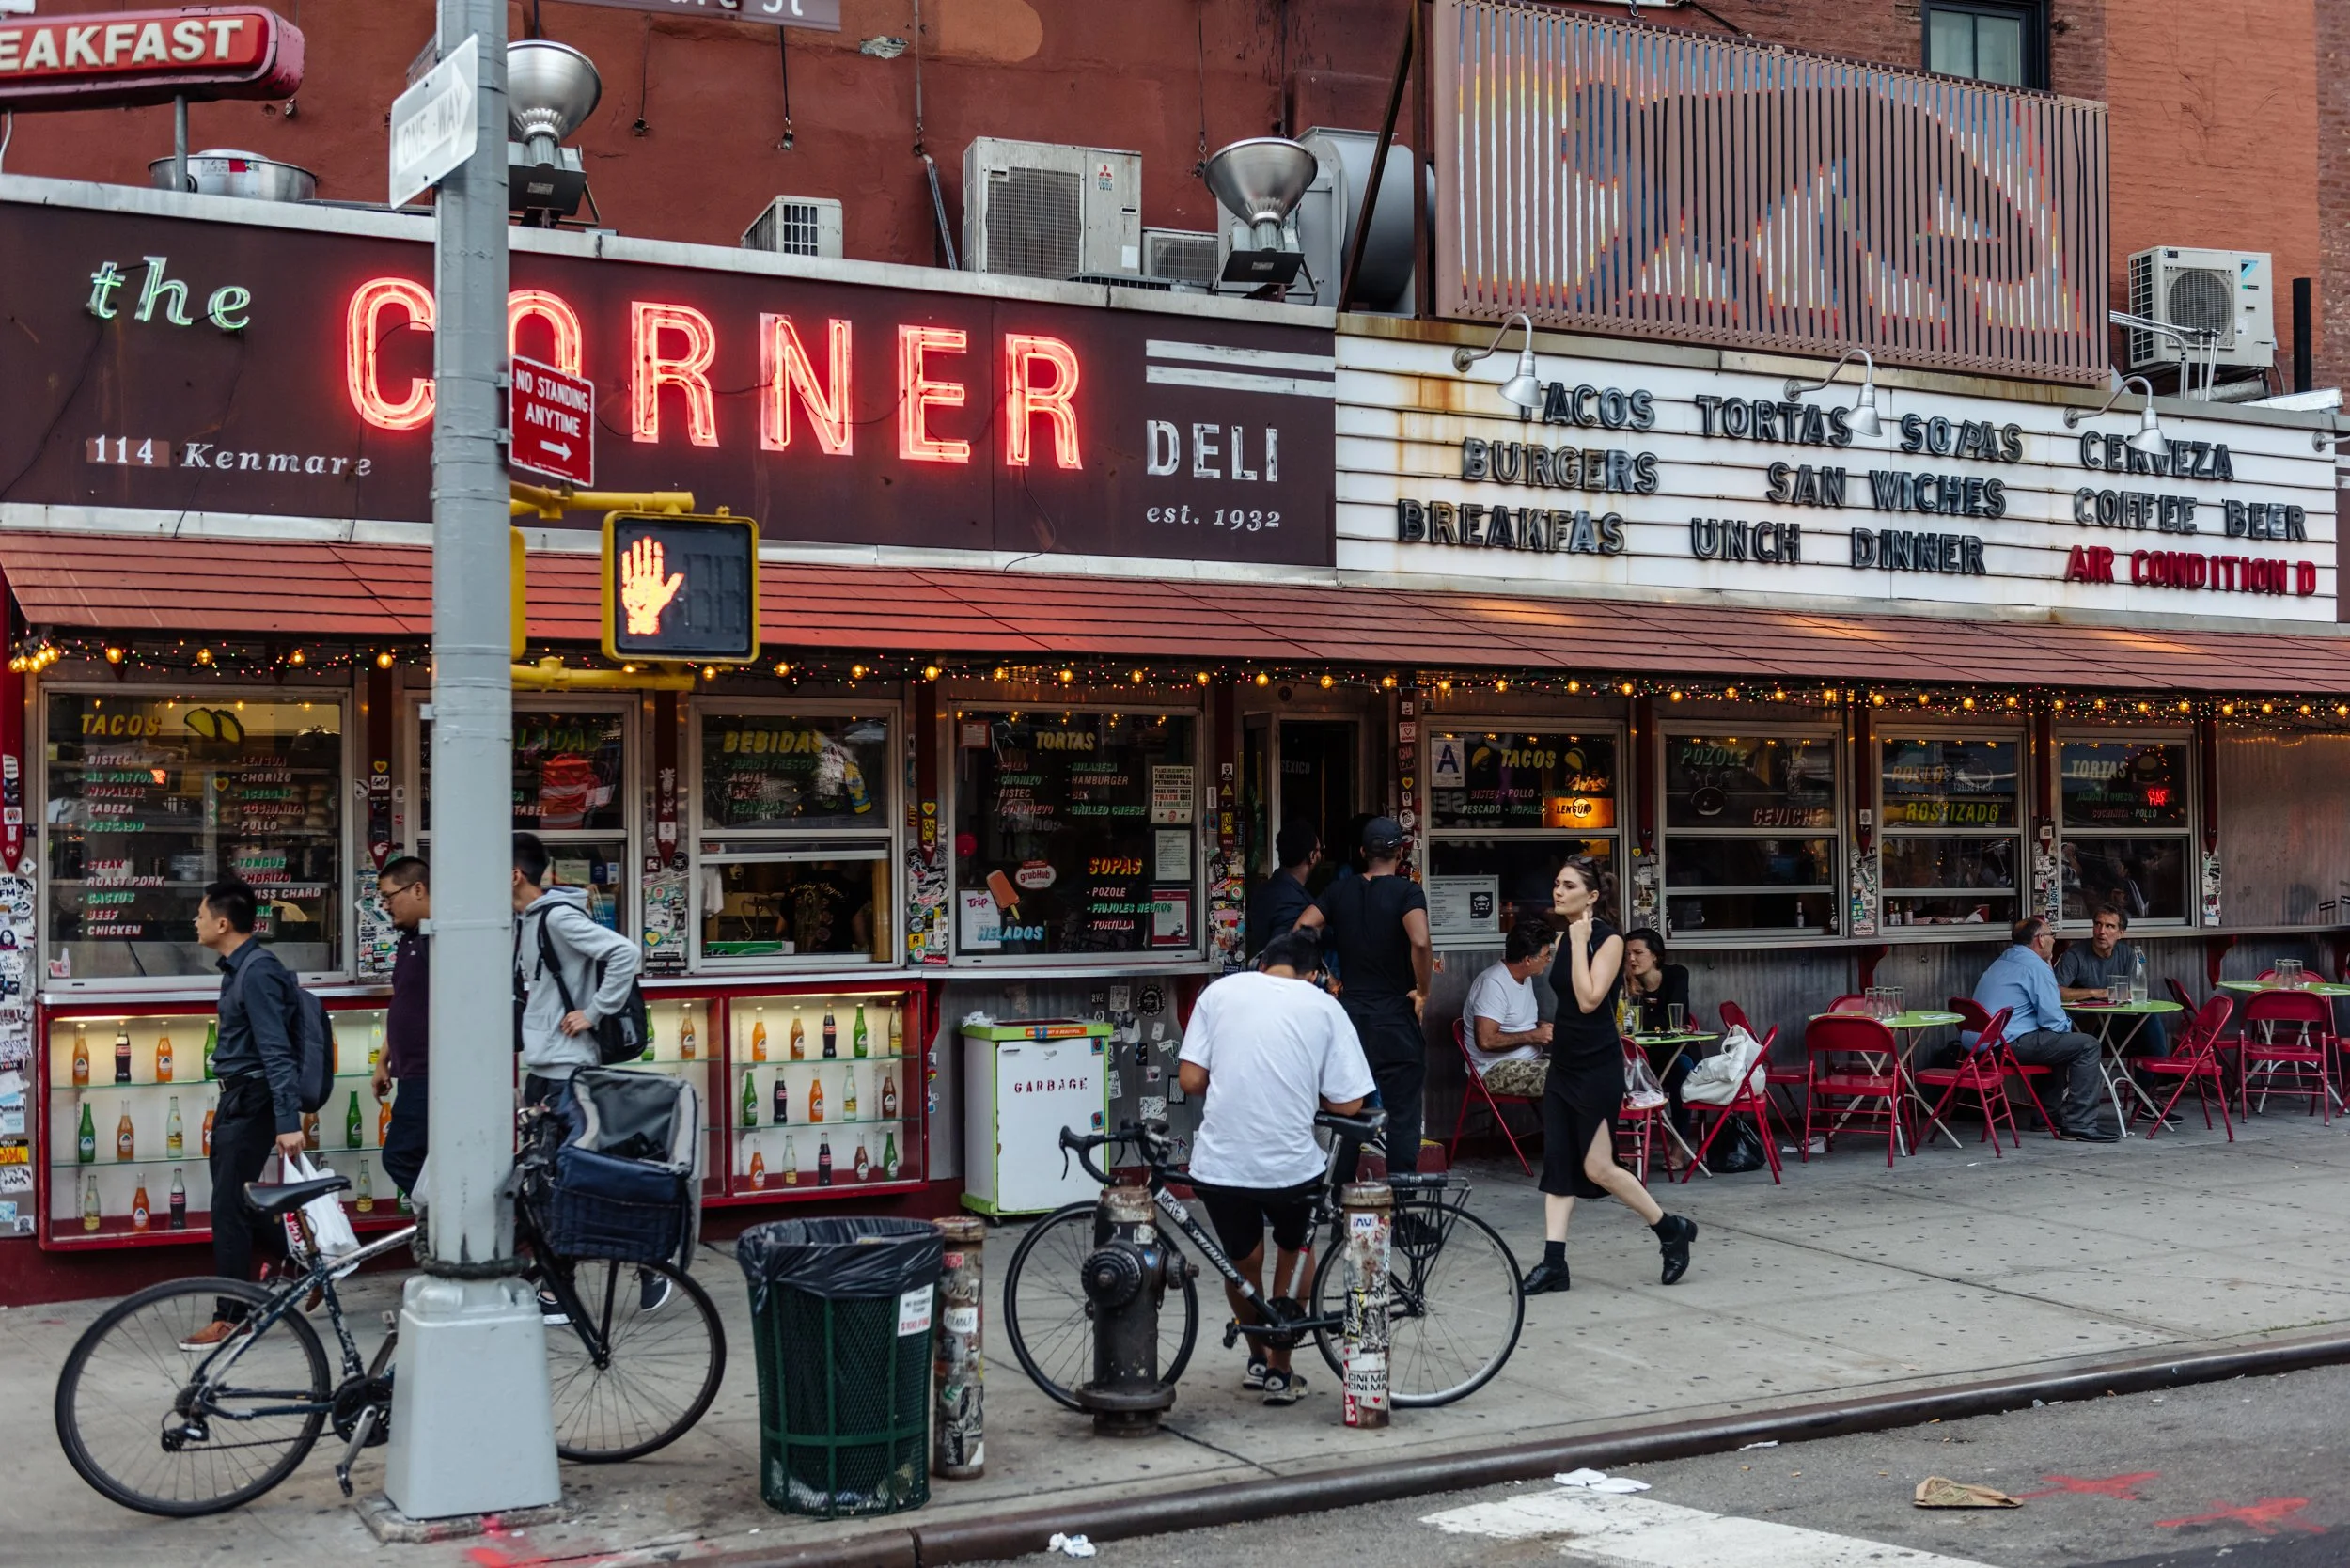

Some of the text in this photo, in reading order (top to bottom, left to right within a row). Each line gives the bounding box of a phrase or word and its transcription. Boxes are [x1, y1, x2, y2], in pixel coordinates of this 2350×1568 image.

[0, 19, 243, 71] EAKFAST
[402, 85, 463, 165] ONE WAY
[86, 256, 251, 331] the
[516, 368, 589, 413] NO STANDING
[525, 401, 582, 438] ANYTIME
[1696, 394, 1853, 448] TORTAS
[1901, 412, 2023, 463] SOPAS
[95, 434, 371, 476] 114 Kenmare
[1147, 420, 1278, 482] DELI
[1463, 436, 2309, 541] BURGERS SAN WICHES COFFEE BEER
[1146, 504, 1281, 531] est. 1932
[1398, 498, 1627, 556] BREAKFAS
[1691, 517, 1802, 564] UNCH
[1851, 527, 1986, 575] DINNER
[2067, 544, 2116, 584] AIR
[2130, 548, 2288, 595] CONDITION
[81, 714, 163, 736] TACOS
[723, 730, 823, 753] BEBIDAS
[1035, 730, 1096, 751] TORTAS
[88, 755, 131, 766] BISTEC
[1436, 744, 1460, 773] A
[1500, 748, 1557, 769] TACOS
[1681, 748, 1748, 767] POZOLE
[2072, 760, 2127, 779] TORTAS
[241, 772, 291, 783] CHORIZO
[1071, 776, 1129, 786] HAMBURGER
[999, 789, 1032, 799] BISTEC
[1508, 788, 1535, 798] POLLO
[87, 804, 133, 815] CABEZA
[1072, 805, 1147, 816] GRILLED CHEESE
[1462, 804, 1502, 815] PESCADO
[1556, 805, 1590, 815] LENGUA
[1905, 801, 2000, 823] ROSTIZADO
[2135, 808, 2157, 819] POLLO
[1752, 808, 1825, 827] CEVICHE
[241, 821, 278, 832] POLLO
[88, 859, 124, 870] STEAK
[239, 857, 287, 869] TONGUE
[1088, 857, 1144, 876] SOPAS
[86, 876, 165, 887] ROAST PORK
[239, 872, 291, 884] CHORIZO
[1020, 870, 1051, 883] grubHub
[87, 892, 135, 904] CACTUS
[281, 887, 321, 899] CHARD
[1092, 887, 1127, 898] POZOLE
[1092, 903, 1173, 914] FRIJOLES NEGROS
[87, 910, 118, 921] BEEF
[87, 925, 142, 937] CHICKEN
[1092, 920, 1136, 931] TORTILLA
[977, 926, 1046, 942] HELADOS
[1014, 1077, 1088, 1094] GARBAGE
[1348, 1372, 1386, 1382] CINEMA
[1348, 1382, 1386, 1392] CINEMA
